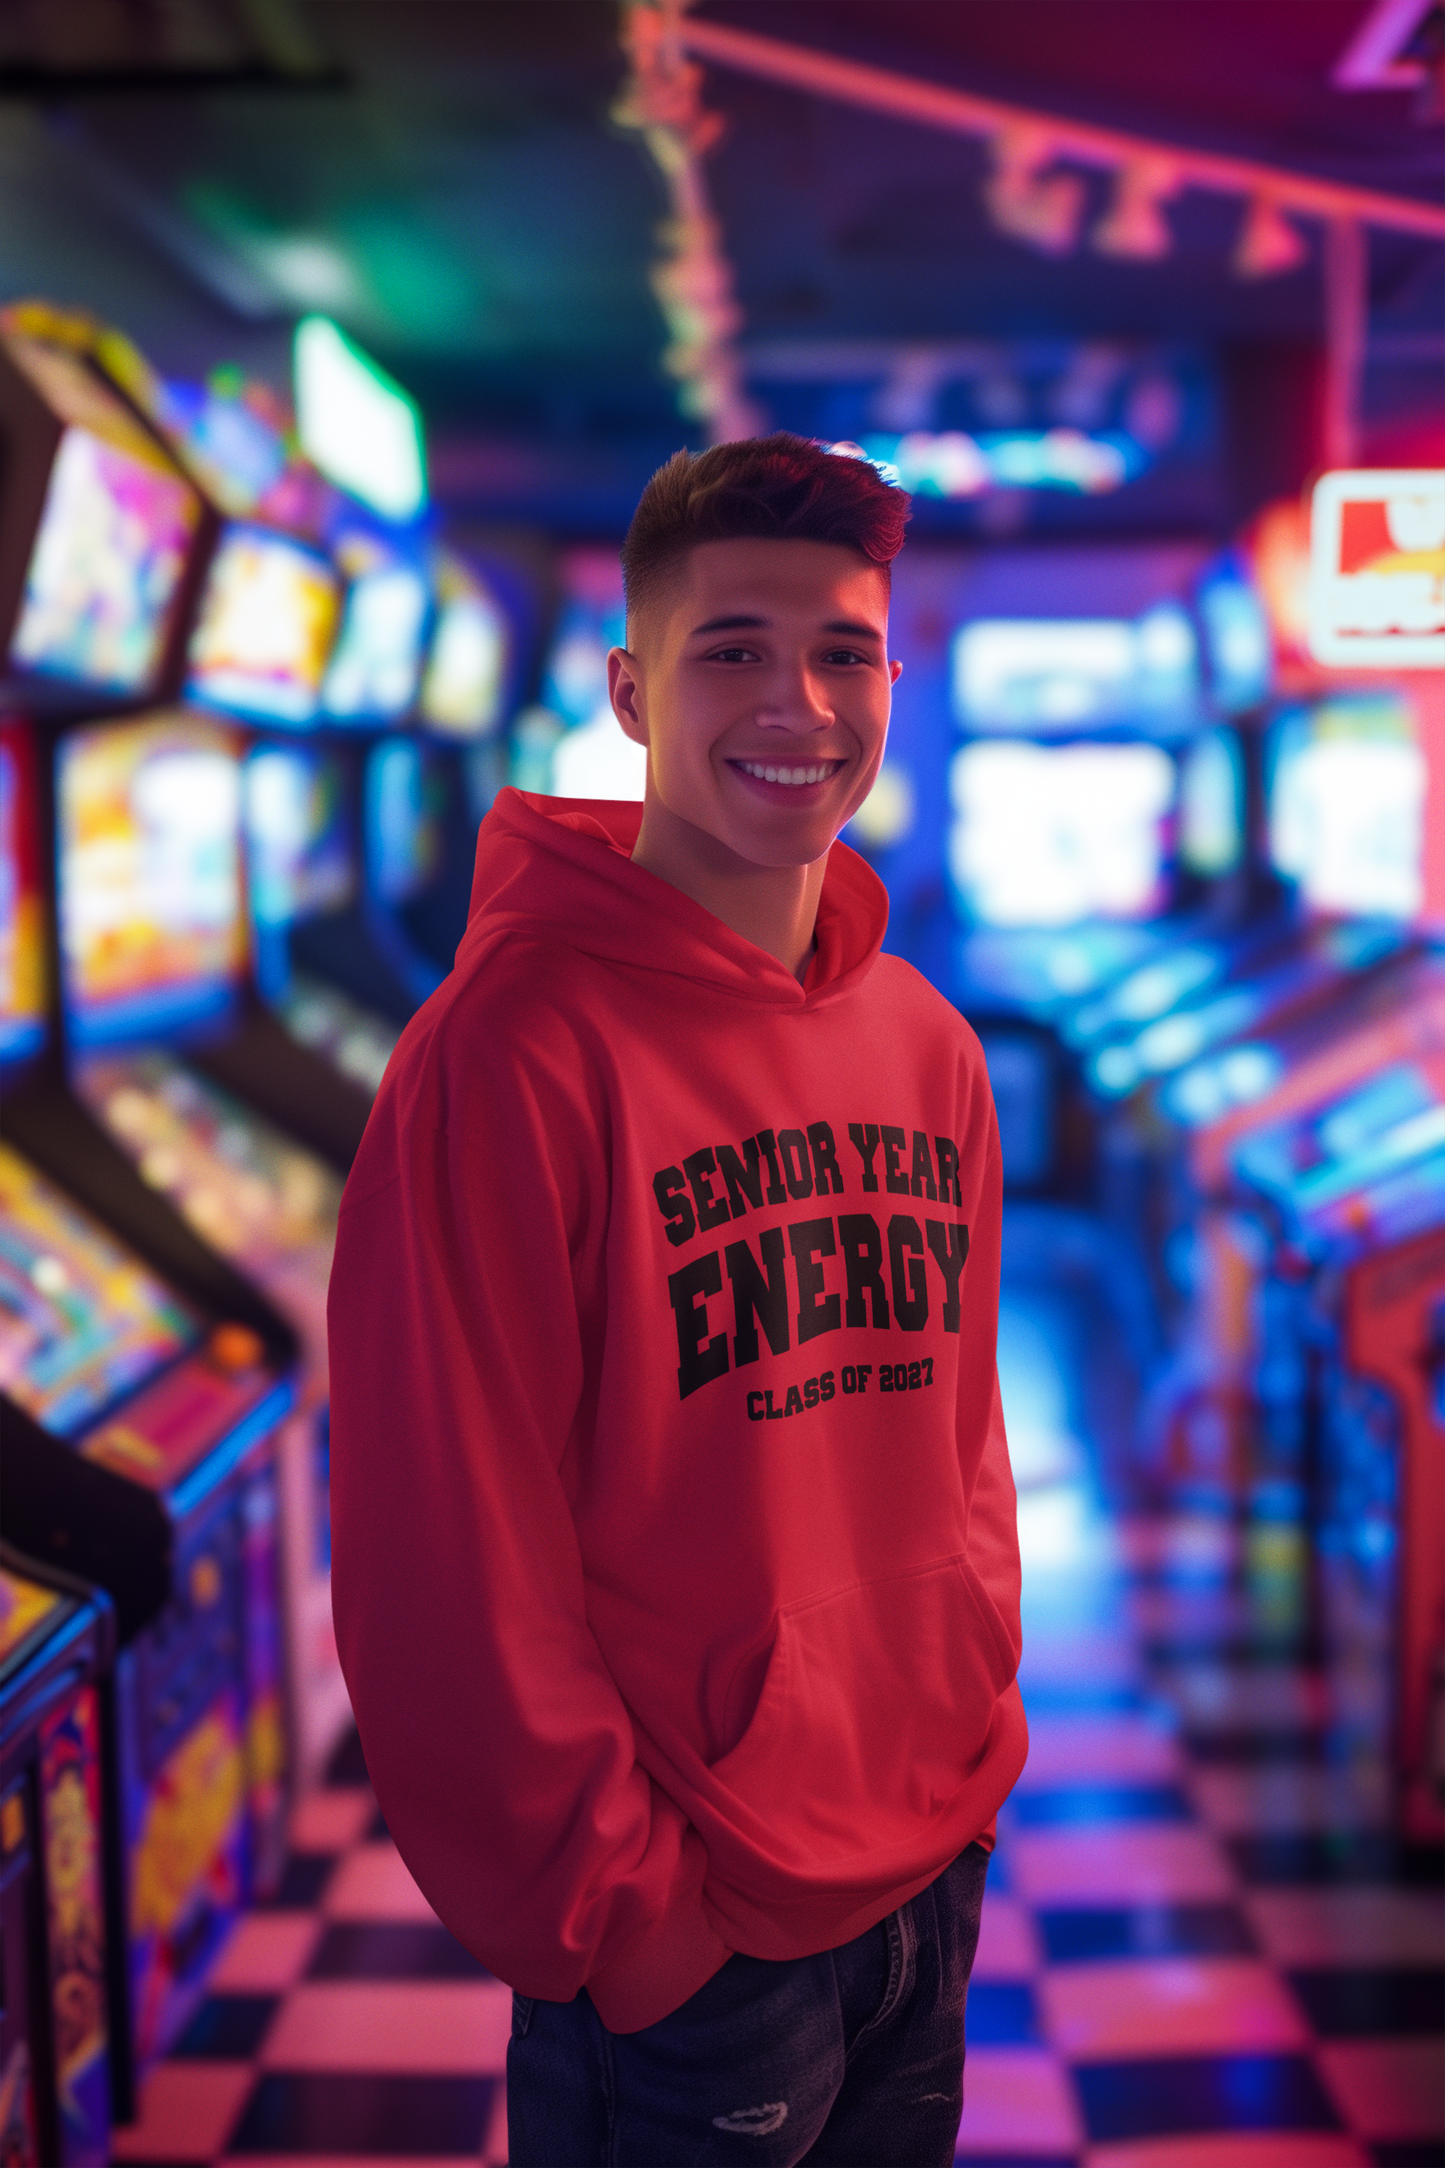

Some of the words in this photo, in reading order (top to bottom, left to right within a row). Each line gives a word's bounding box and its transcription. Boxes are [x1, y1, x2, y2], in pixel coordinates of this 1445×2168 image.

[652, 1120, 844, 1248] SENIOR
[847, 1122, 962, 1208] YEAR
[667, 1213, 970, 1401] ENERGY
[746, 1370, 836, 1422] CLASS
[841, 1364, 873, 1395] OF
[879, 1357, 935, 1393] 2027
